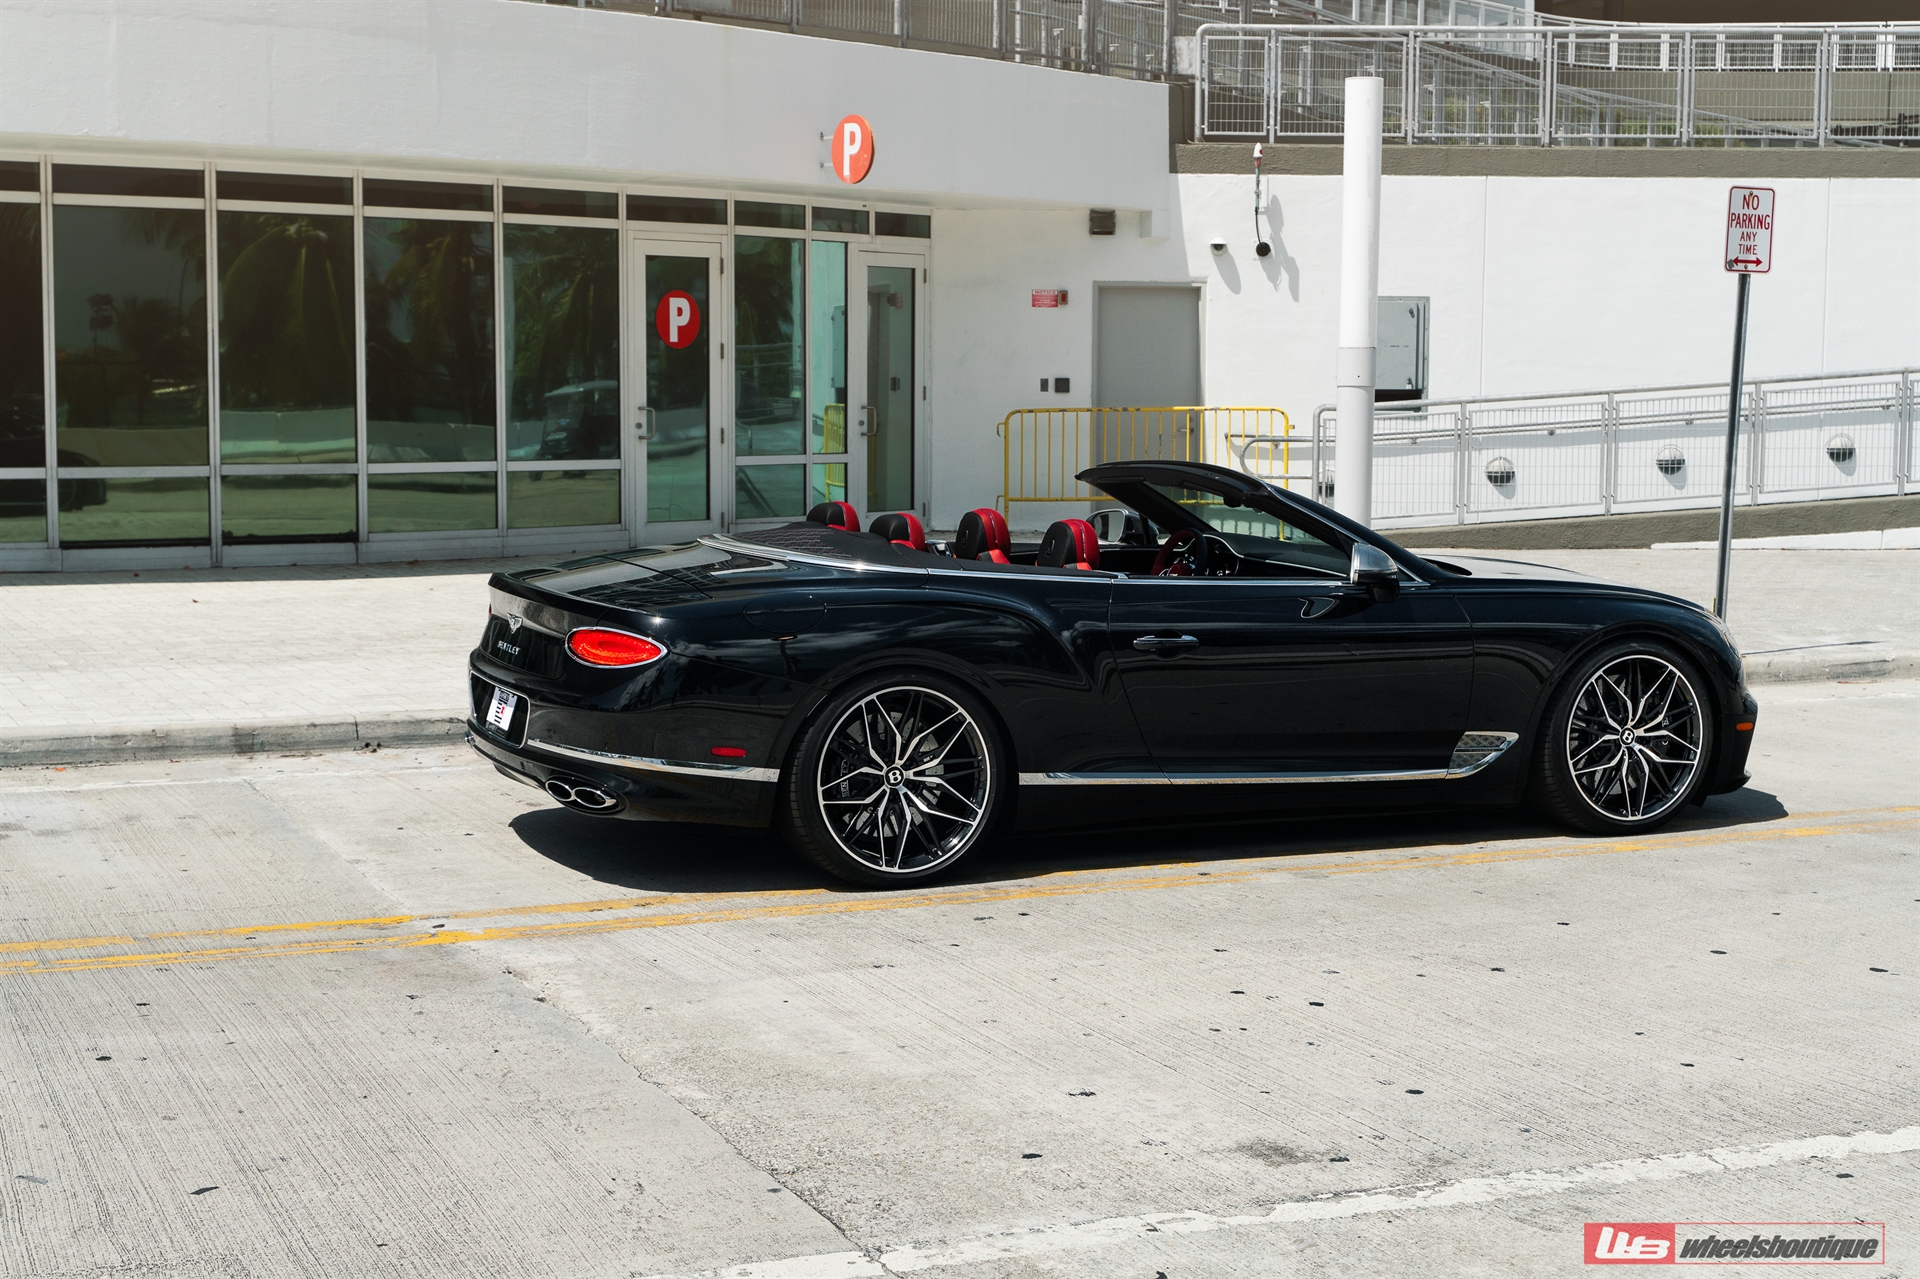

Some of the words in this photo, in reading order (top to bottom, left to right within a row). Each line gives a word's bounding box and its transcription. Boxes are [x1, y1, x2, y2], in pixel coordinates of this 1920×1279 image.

[842, 122, 862, 176] P
[1742, 194, 1760, 211] NO
[1730, 212, 1771, 230] PARKING
[1739, 231, 1758, 242] ANY
[1738, 243, 1758, 256] TIME
[669, 297, 691, 343] P
[497, 640, 521, 656] BENTLEY
[1622, 730, 1634, 743] B
[888, 770, 902, 784] B
